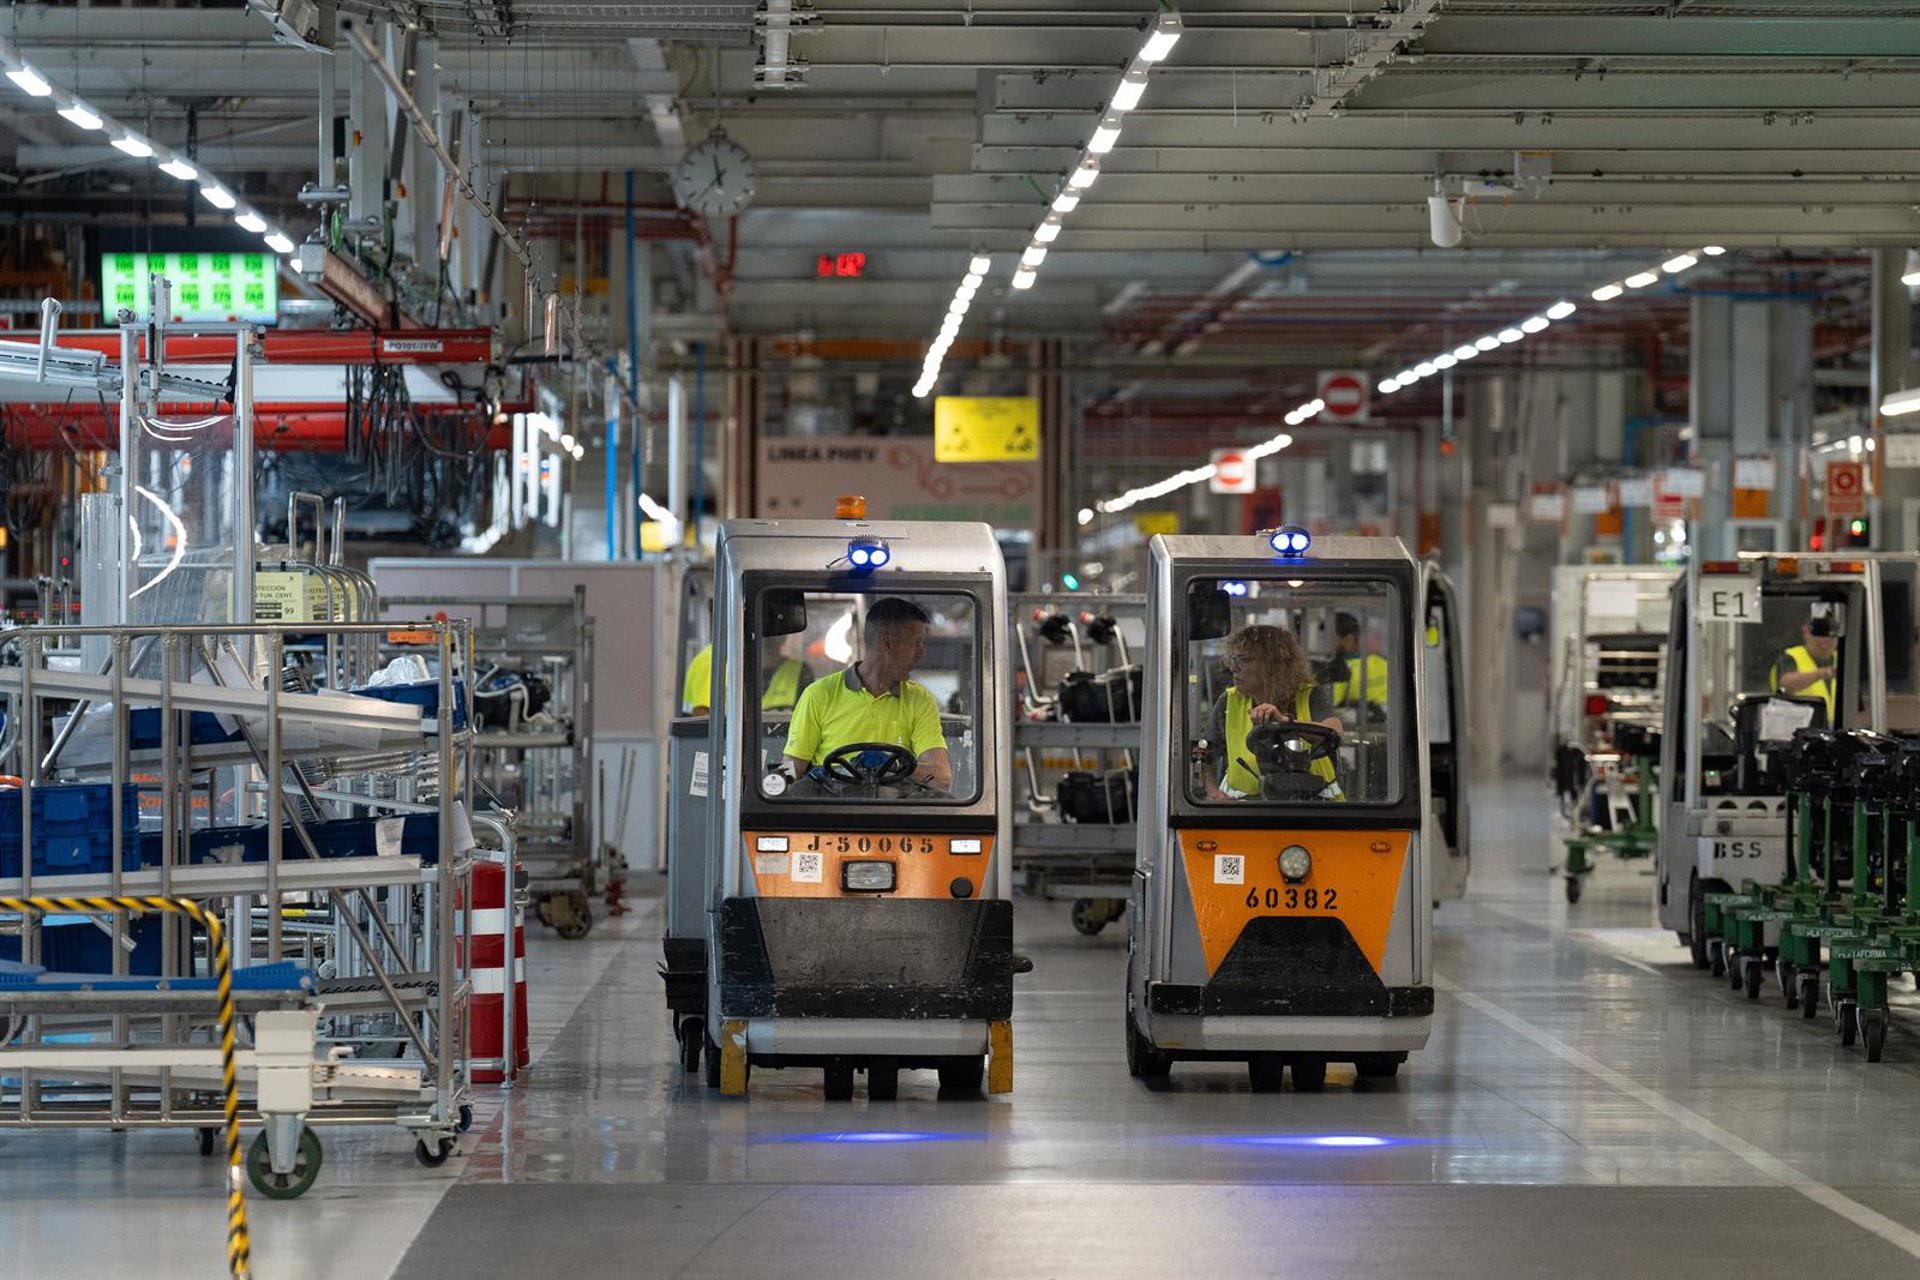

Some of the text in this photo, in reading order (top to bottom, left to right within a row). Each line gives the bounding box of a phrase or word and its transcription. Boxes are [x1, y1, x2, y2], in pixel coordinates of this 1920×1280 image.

[767, 448, 877, 462] LINEA PHEV
[1712, 591, 1749, 618] E1
[807, 835, 934, 854] J-50065
[1714, 841, 1762, 859] BSS
[1246, 887, 1338, 910] 60382
